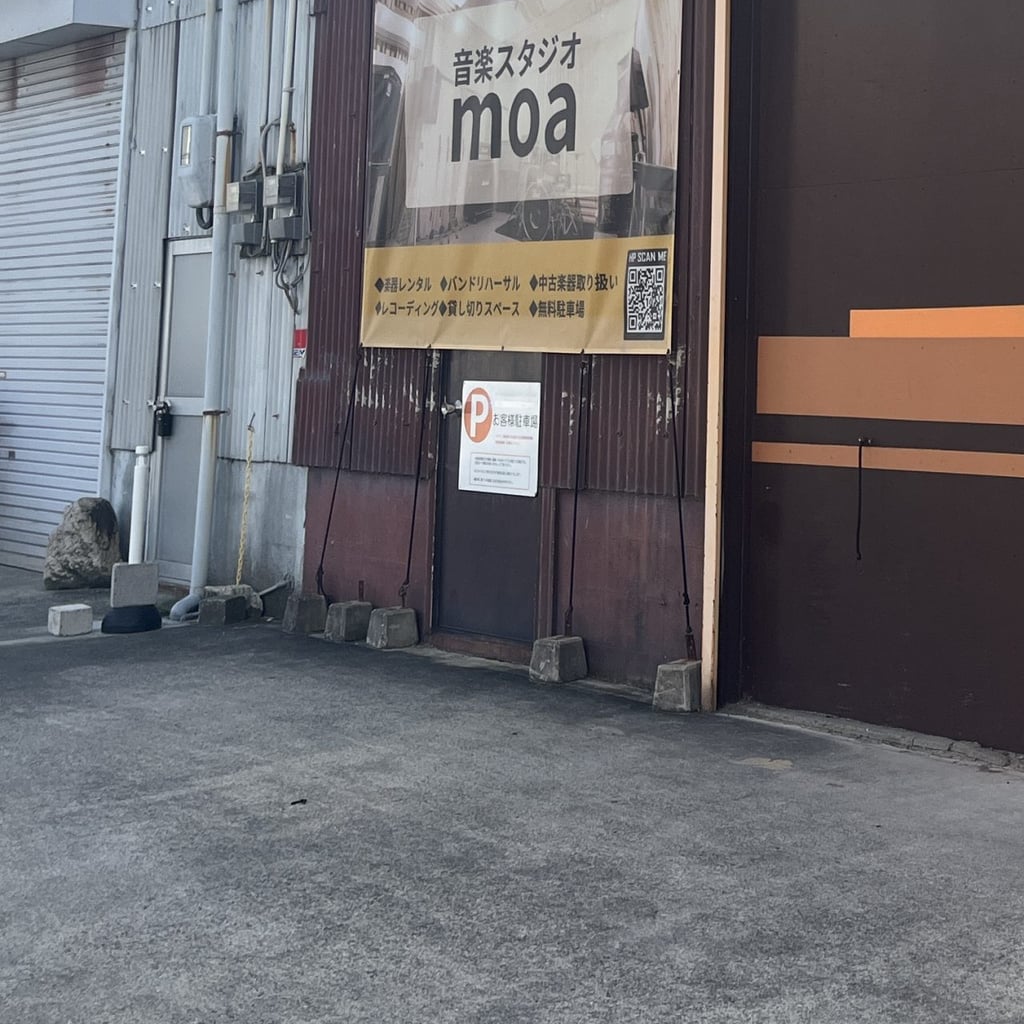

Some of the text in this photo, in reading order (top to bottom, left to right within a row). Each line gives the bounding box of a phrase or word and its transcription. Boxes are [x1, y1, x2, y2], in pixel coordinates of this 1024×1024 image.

[453, 32, 581, 87] 音楽スタジオ
[451, 82, 577, 162] moa
[637, 251, 656, 263] SCAN
[657, 250, 668, 262] ME
[384, 273, 618, 293] 楽器レンタル バンドリハーサル 中古楽器取り扱い
[381, 299, 585, 318] レコーディング 貸し切りスペース 無料駐車場
